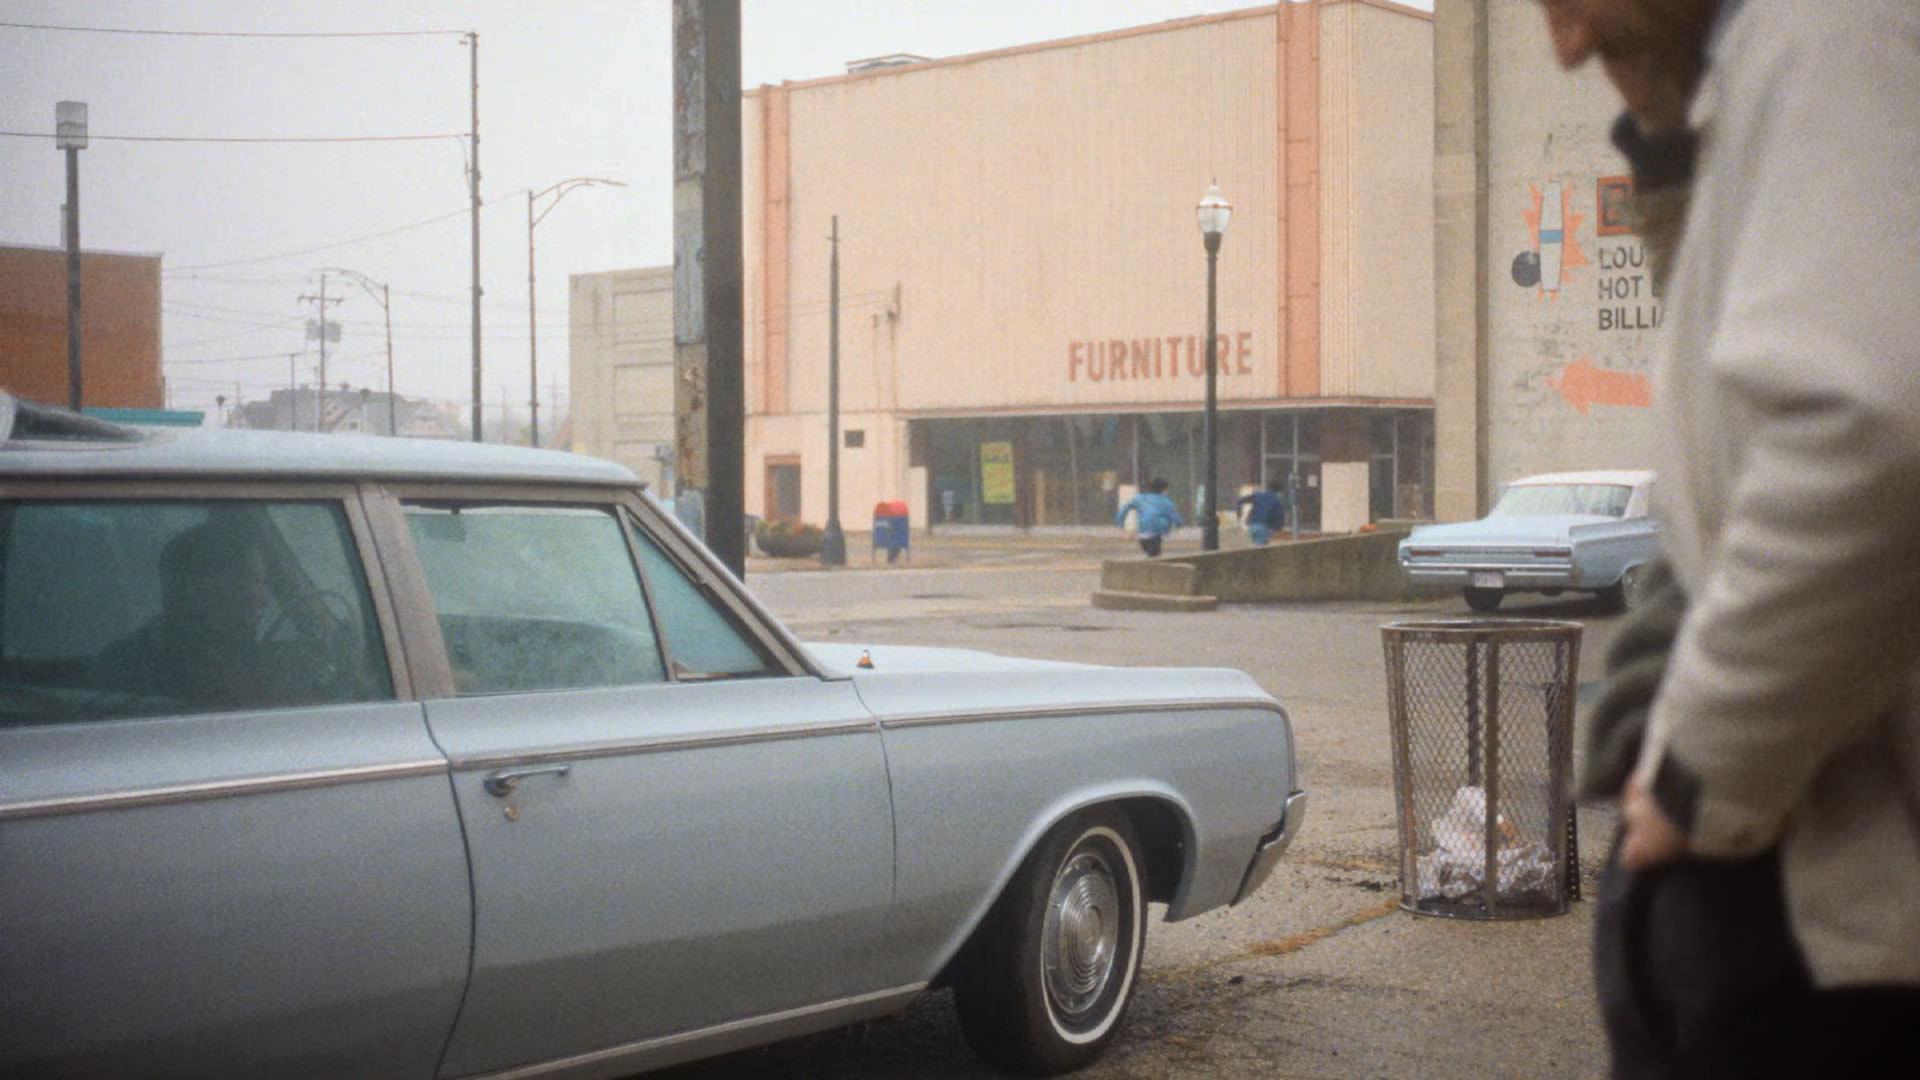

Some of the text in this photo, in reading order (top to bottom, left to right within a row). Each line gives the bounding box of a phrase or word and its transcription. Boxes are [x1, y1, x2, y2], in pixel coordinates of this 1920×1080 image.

[1600, 247, 1645, 270] LOU
[1599, 276, 1643, 299] HOT
[1068, 332, 1253, 382] FURNITURE
